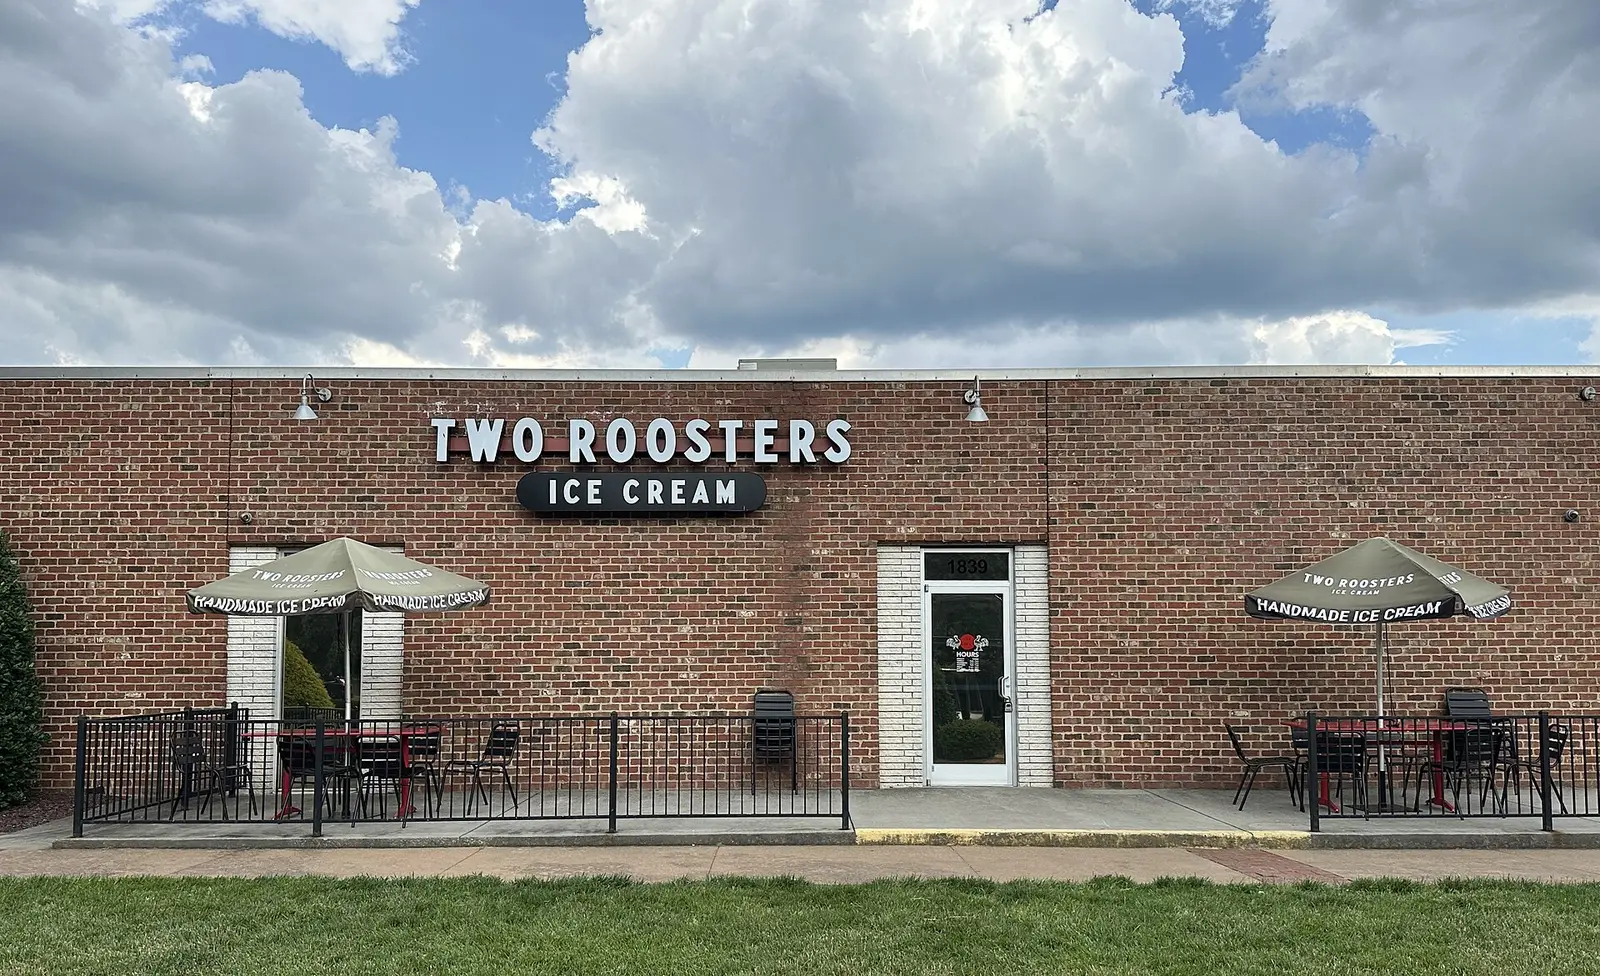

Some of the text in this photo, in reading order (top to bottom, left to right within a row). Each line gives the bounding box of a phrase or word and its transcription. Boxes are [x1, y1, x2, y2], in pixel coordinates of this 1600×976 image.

[431, 417, 853, 464] TWO ROOSTERS
[549, 479, 736, 504] ICE CREAM
[253, 569, 346, 583] TWO ROOSTERS
[948, 559, 988, 574] 1839
[1303, 573, 1415, 589] TWO ROOSTERS
[194, 595, 275, 614] HANDMADE
[276, 599, 300, 614] ICE
[429, 594, 447, 609] ICE
[447, 588, 486, 607] CREAM
[1257, 598, 1350, 622] HANDMADE
[1353, 609, 1381, 622] ICE
[1384, 601, 1442, 621] CREAM
